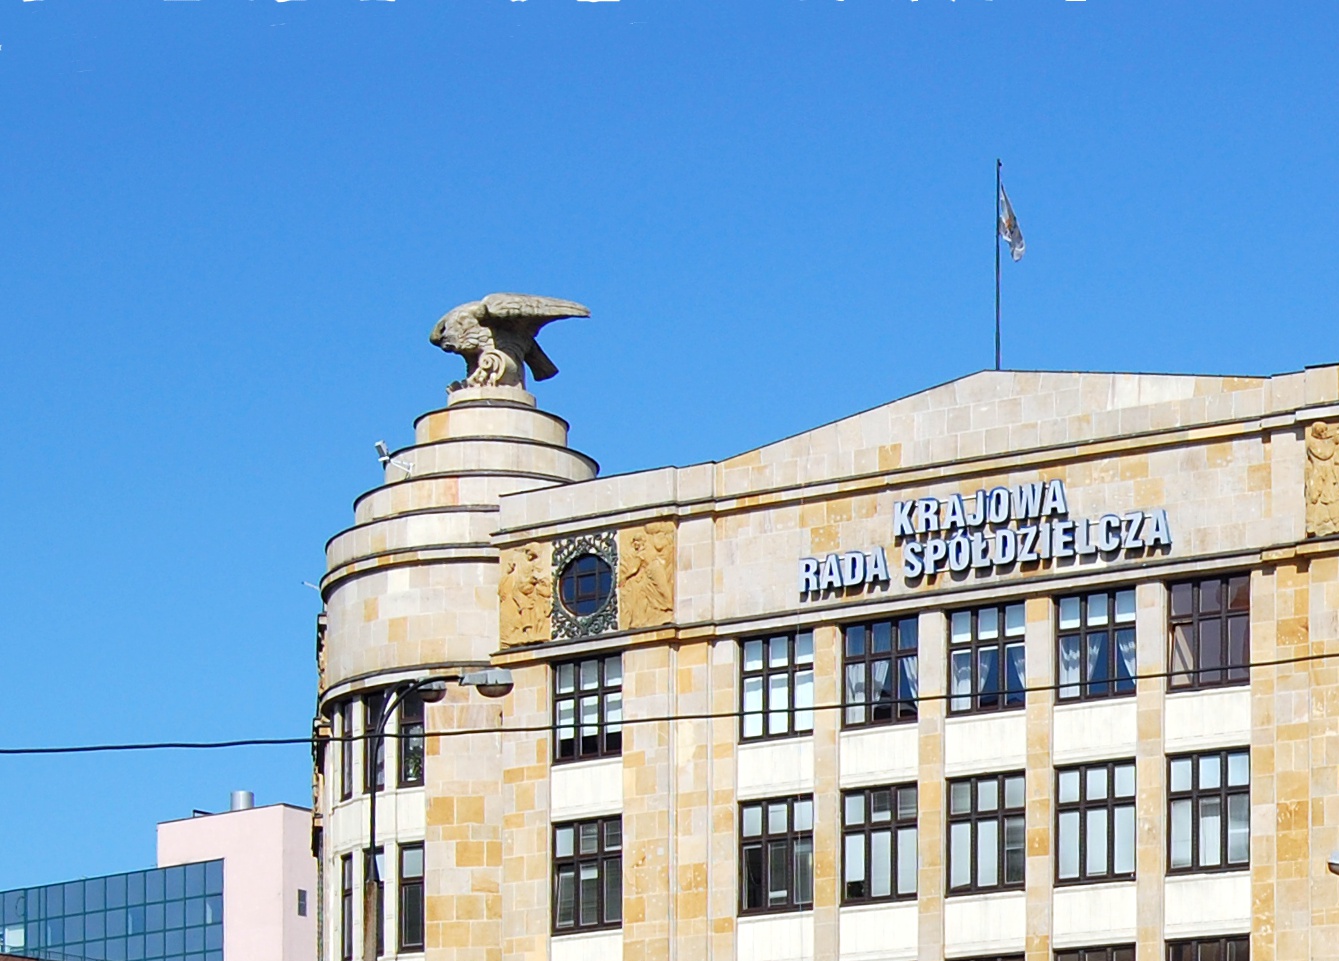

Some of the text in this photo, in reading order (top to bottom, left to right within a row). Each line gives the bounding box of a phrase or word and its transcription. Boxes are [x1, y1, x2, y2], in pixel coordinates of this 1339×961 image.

[893, 479, 1069, 537] KRAJOWA
[800, 509, 1172, 593] RADA SPÓŁDZIELCZA
